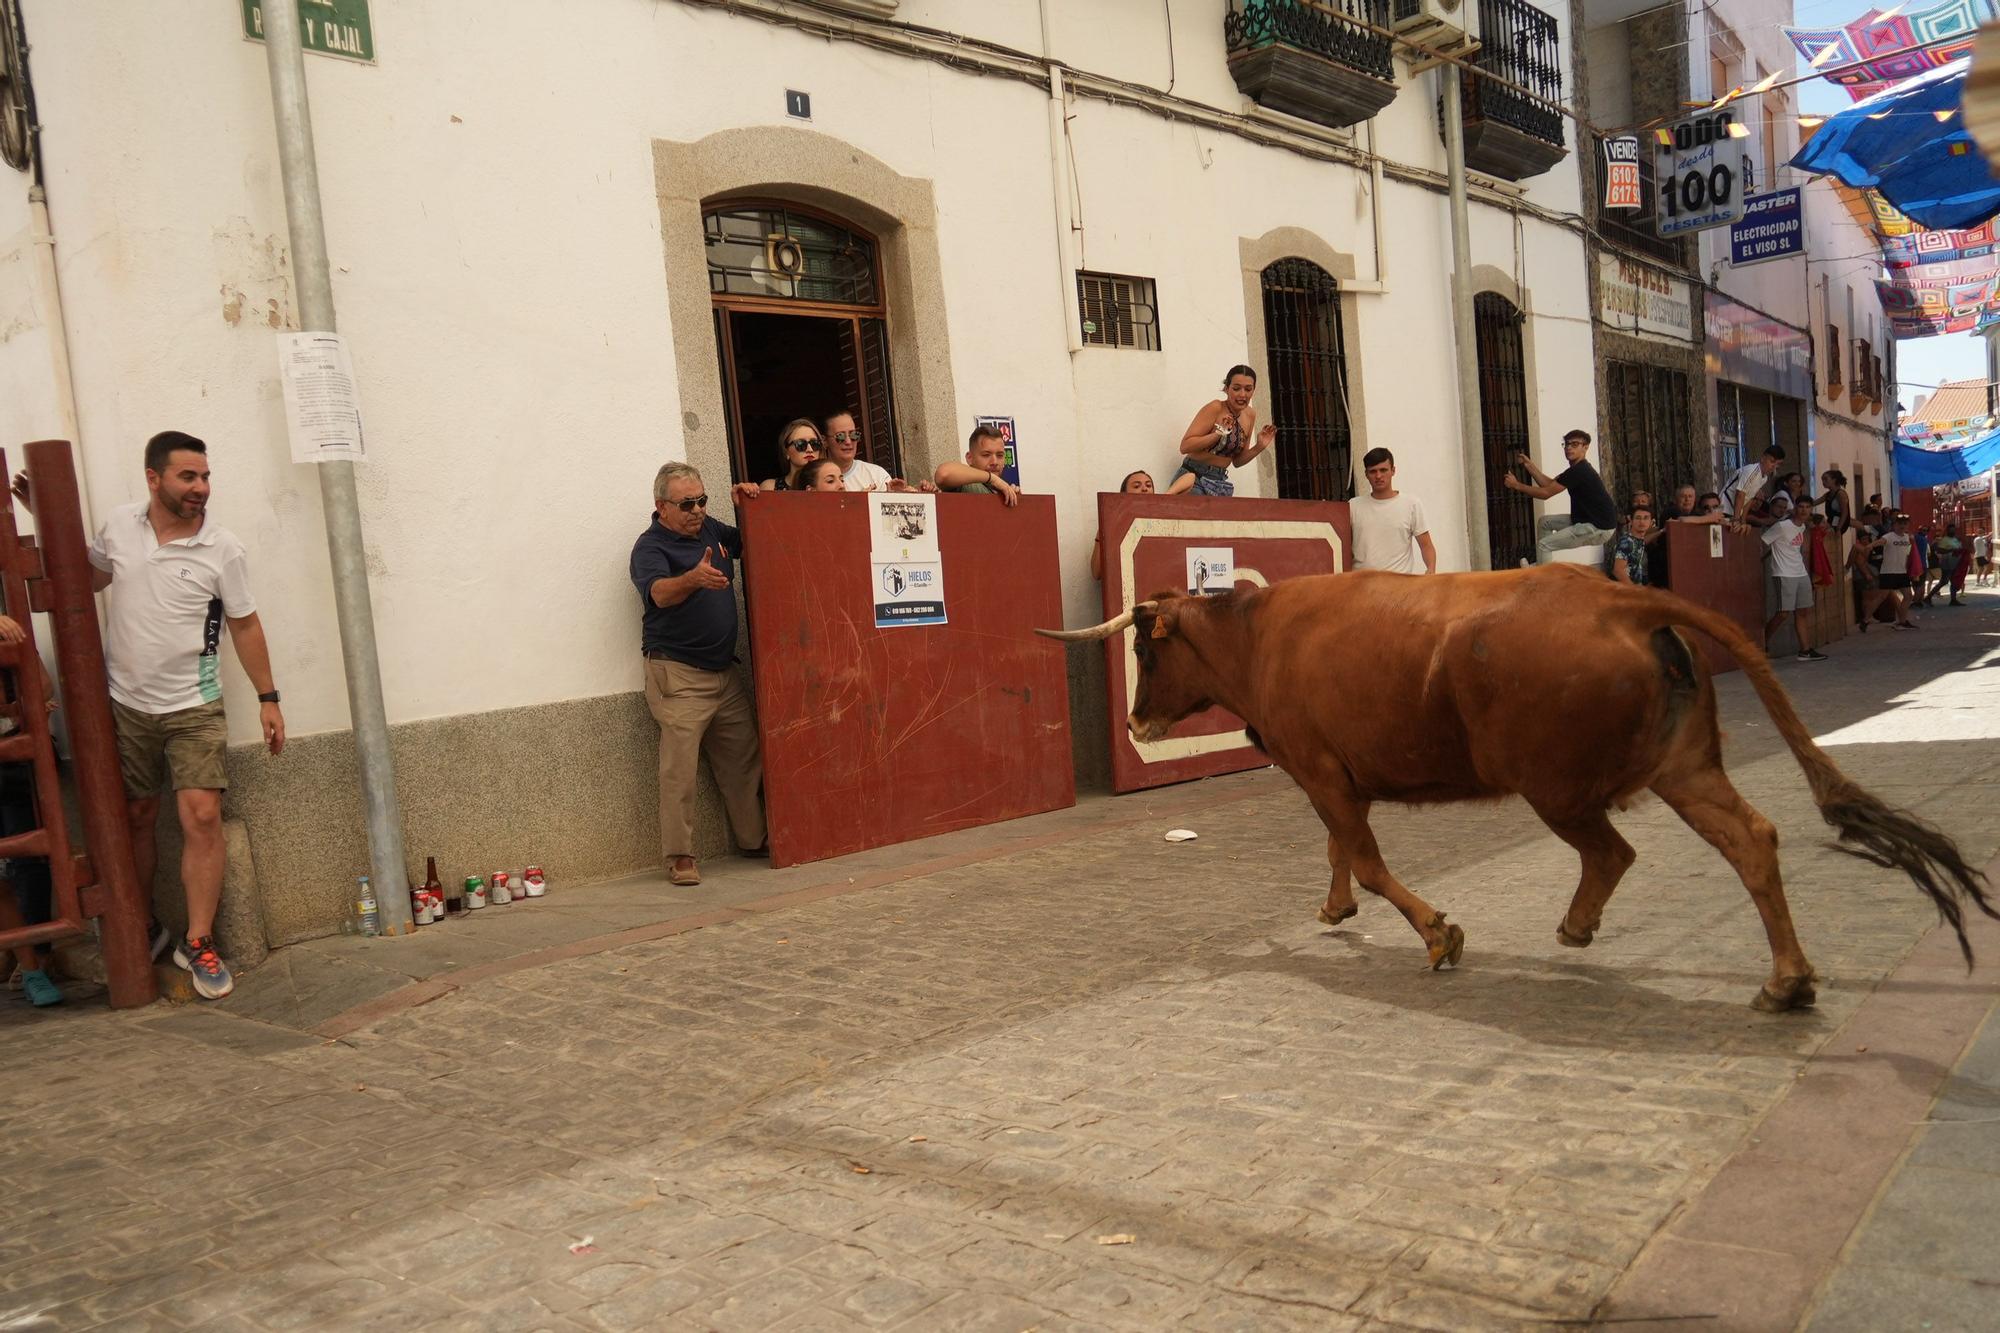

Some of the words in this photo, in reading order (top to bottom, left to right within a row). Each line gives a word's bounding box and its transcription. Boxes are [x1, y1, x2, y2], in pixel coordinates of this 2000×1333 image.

[306, 18, 315, 45] Y
[324, 22, 364, 54] CAJAL
[796, 95, 802, 113] 1
[1609, 142, 1637, 159] VENDE
[1613, 167, 1631, 184] 610
[1612, 185, 1631, 202] 617
[1661, 164, 1732, 217] 100
[1662, 210, 1732, 232] PESETAS
[1734, 219, 1799, 242] ELECTRICIDAD
[1742, 244, 1753, 257] EL
[1755, 240, 1777, 254] VISO
[1780, 237, 1790, 249] SL
[908, 571, 932, 581] HIELOS
